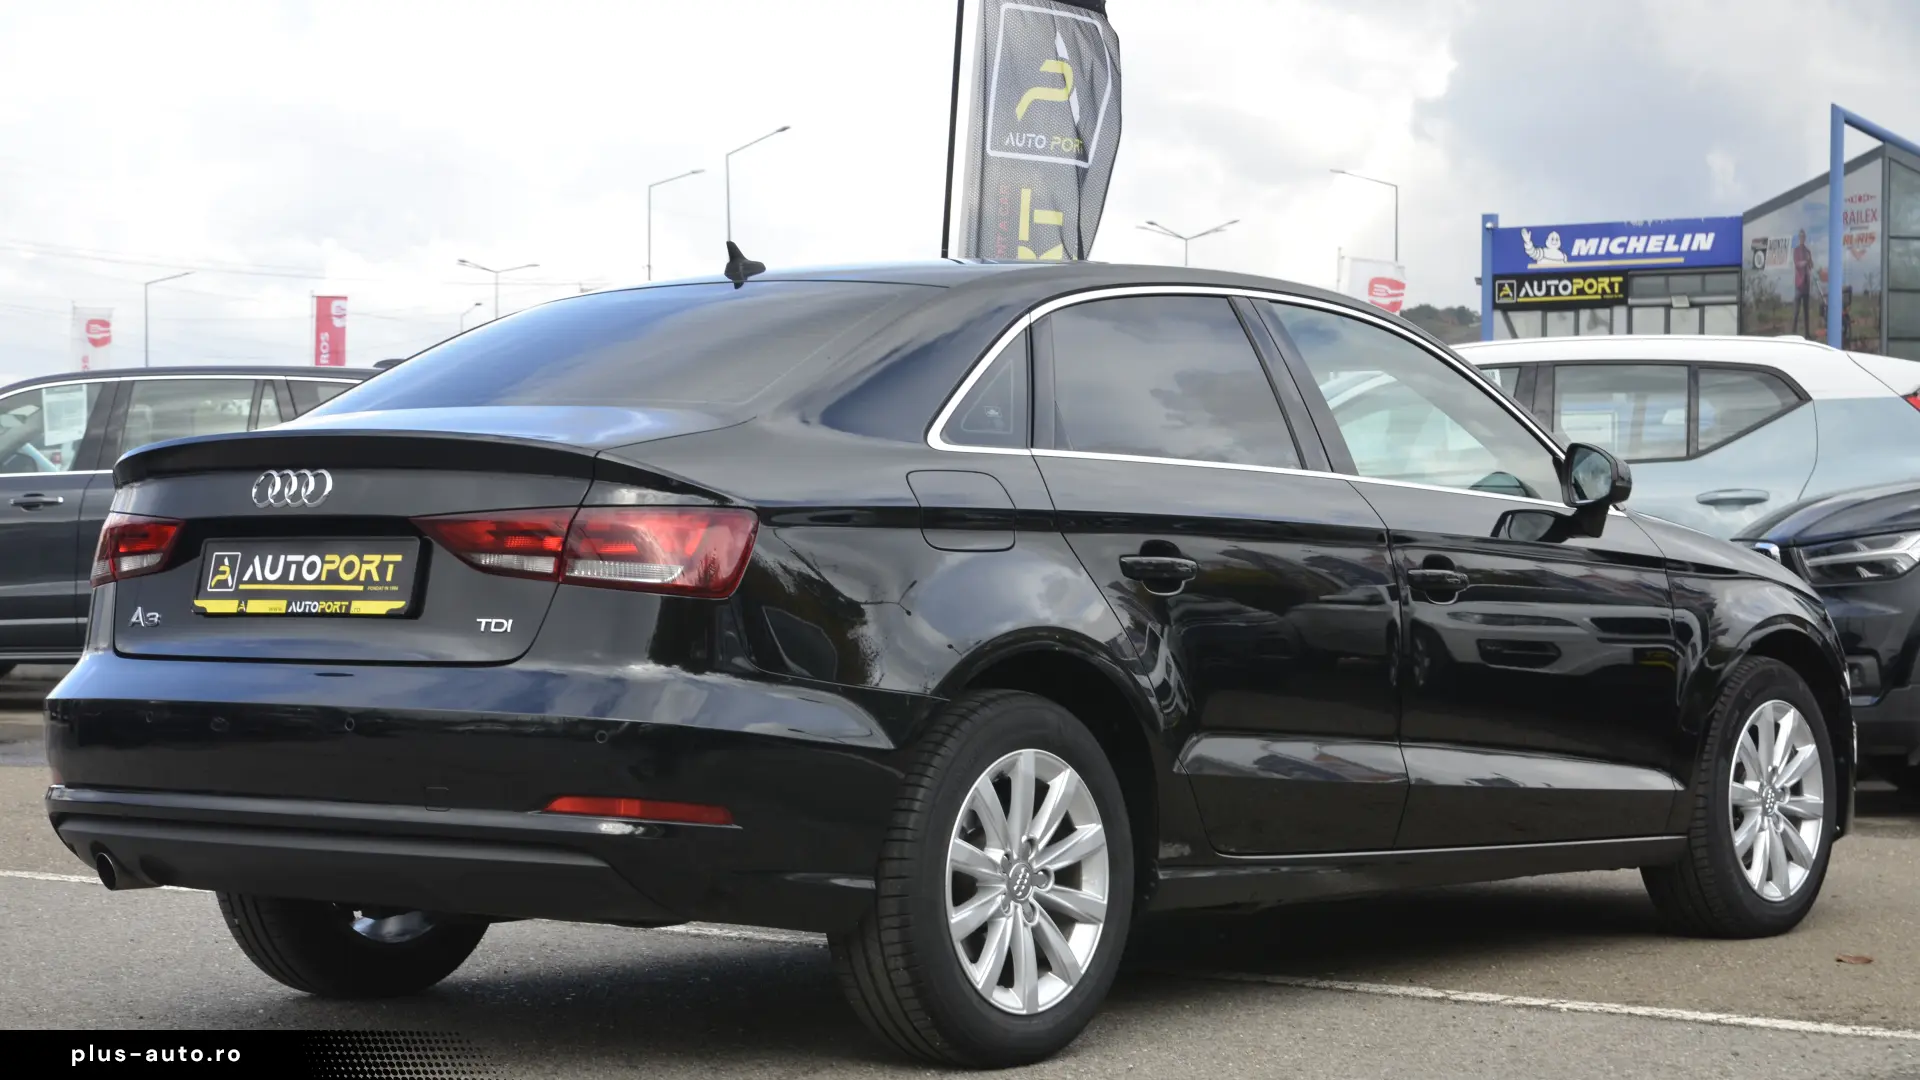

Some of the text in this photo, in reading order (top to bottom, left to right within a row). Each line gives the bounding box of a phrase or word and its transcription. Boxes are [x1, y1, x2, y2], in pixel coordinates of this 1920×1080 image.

[1005, 132, 1047, 149] AUTO
[1571, 232, 1715, 256] MICHELIN
[1519, 276, 1623, 297] AUTOPORT
[242, 554, 402, 582] AUTOPORT
[129, 606, 161, 627] A3
[288, 601, 349, 613] AUTOPORT
[476, 618, 513, 632] TDI
